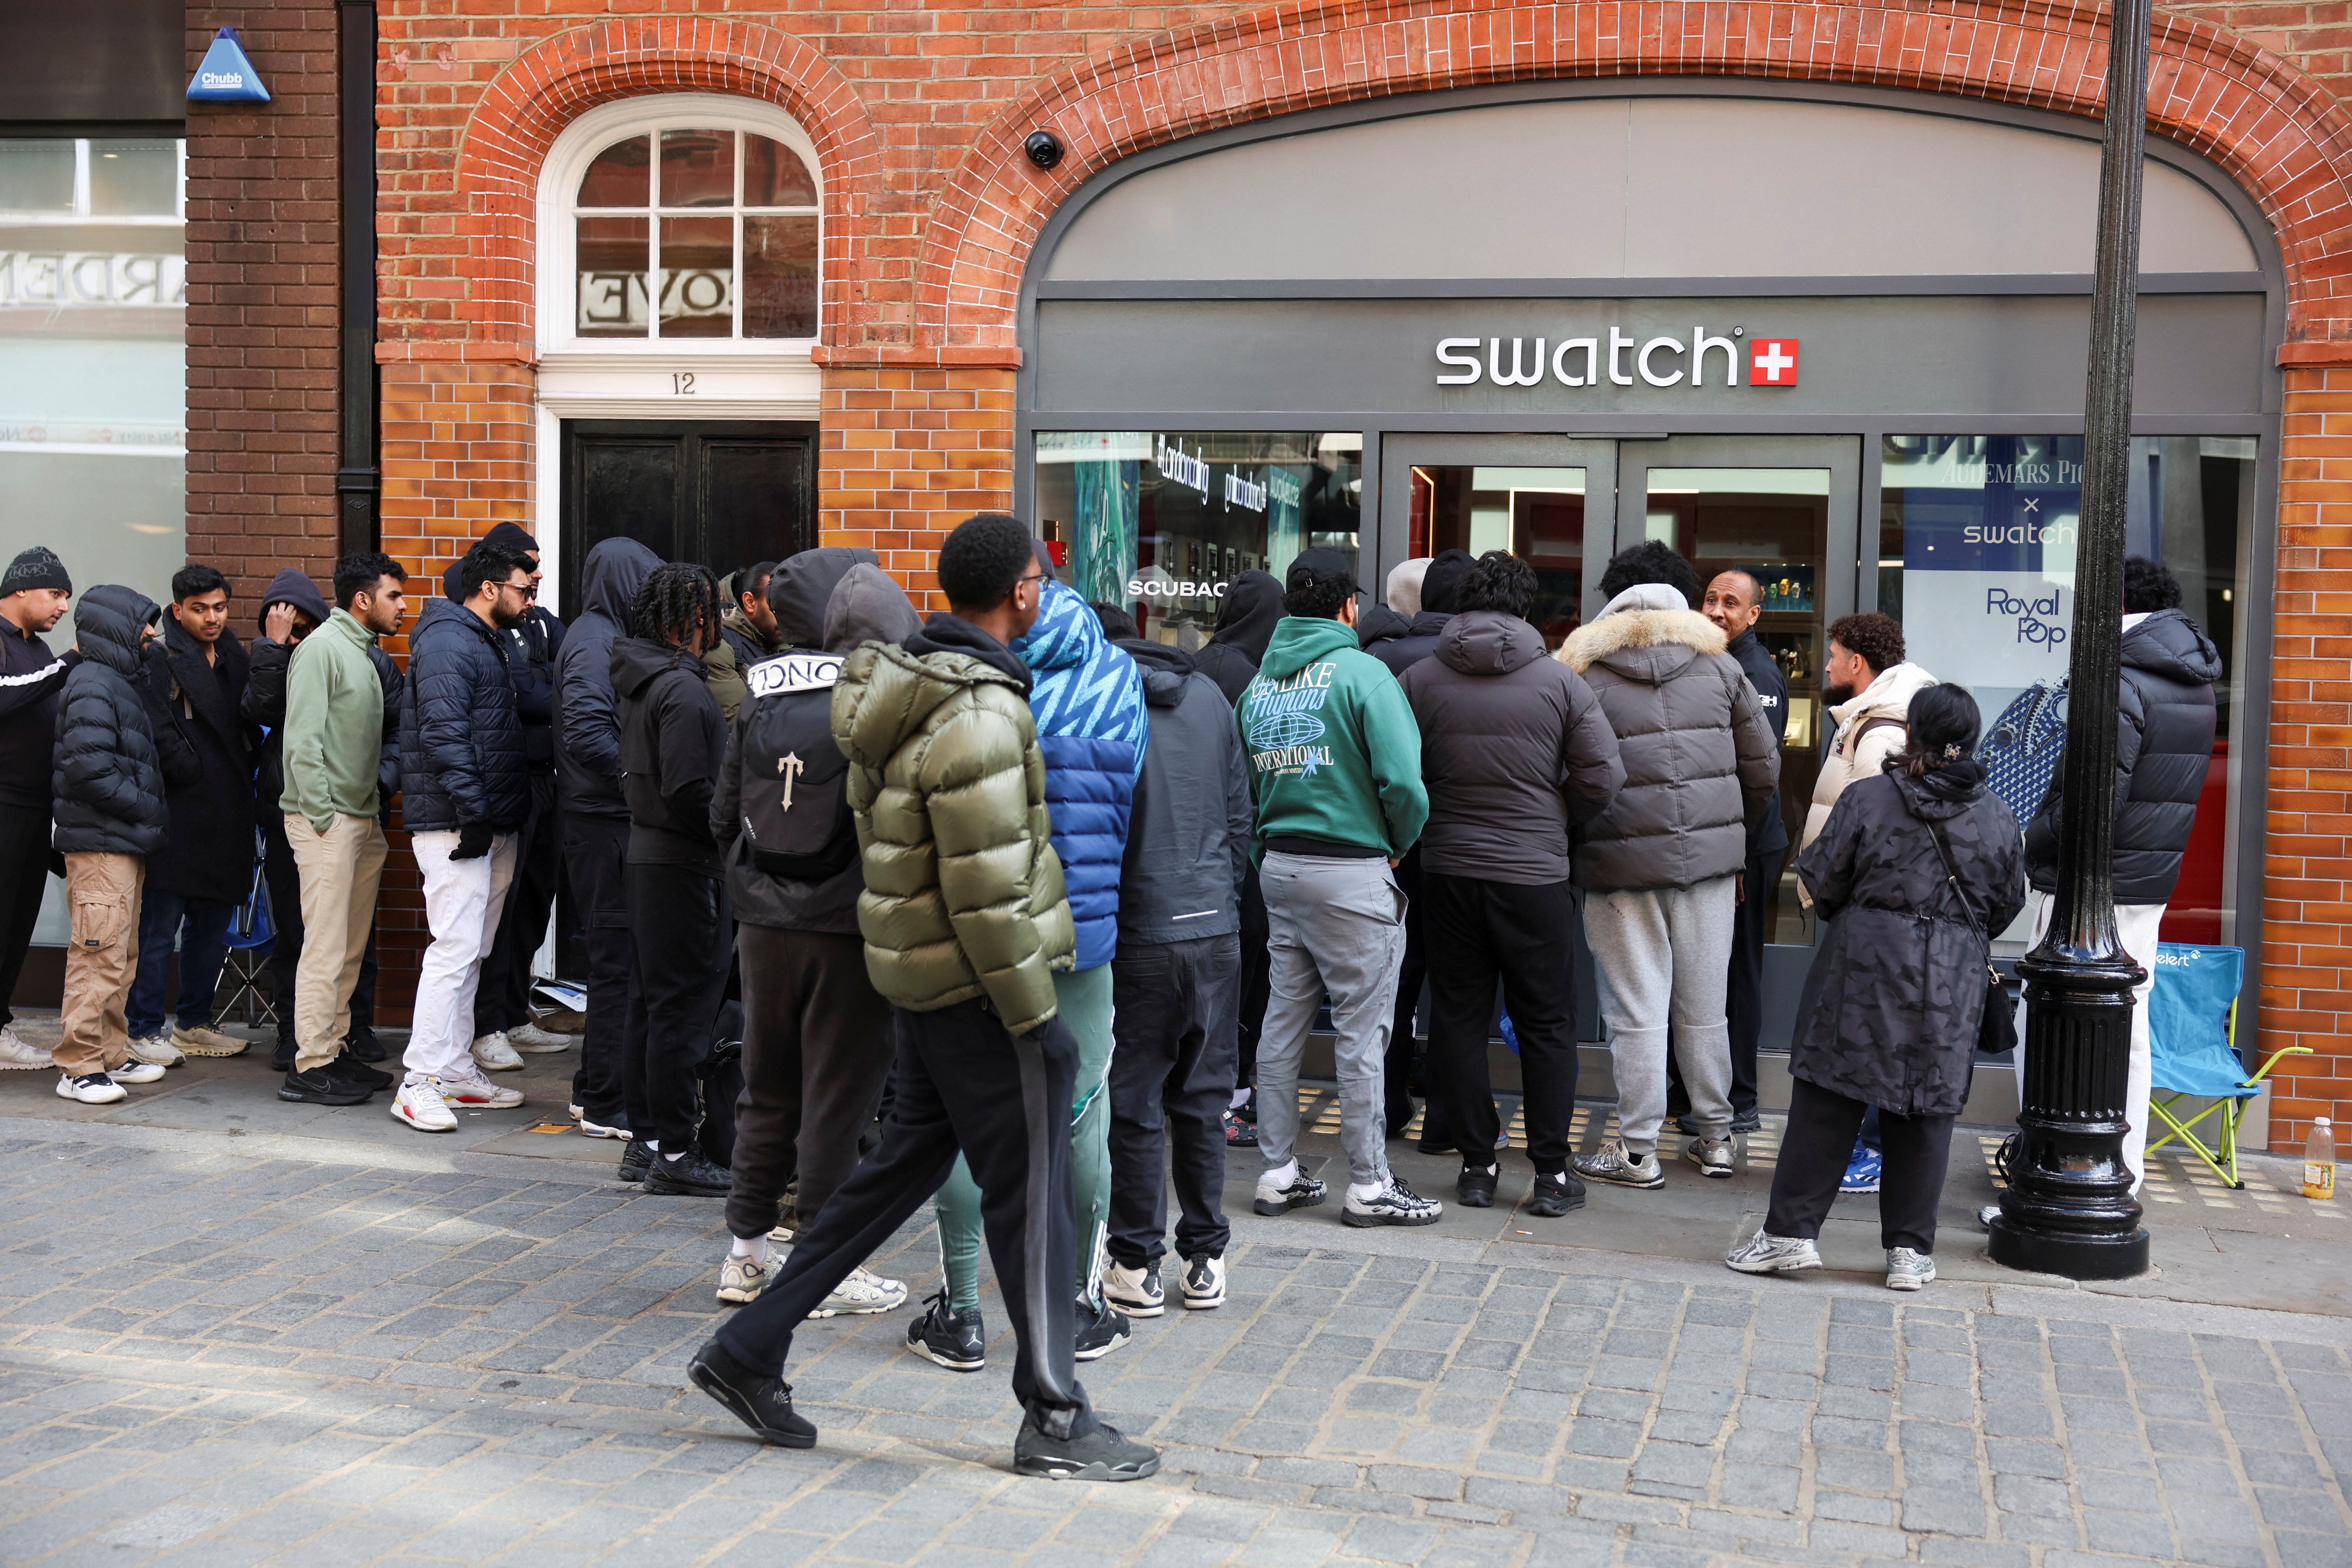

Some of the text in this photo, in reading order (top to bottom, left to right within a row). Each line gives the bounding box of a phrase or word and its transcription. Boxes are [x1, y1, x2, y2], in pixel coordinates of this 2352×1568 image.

[201, 72, 242, 83] Chubb
[1436, 327, 1738, 387] swatch
[672, 372, 695, 394] 12
[1940, 460, 2050, 484] AUDEMARS
[1964, 523, 2075, 544] swatch
[1987, 588, 2059, 623] Royal
[1252, 663, 1337, 698] UNLIKE
[1247, 680, 1328, 723] Humans
[1252, 746, 1334, 772] INTERNTIONAL
[2156, 953, 2190, 967] elert
